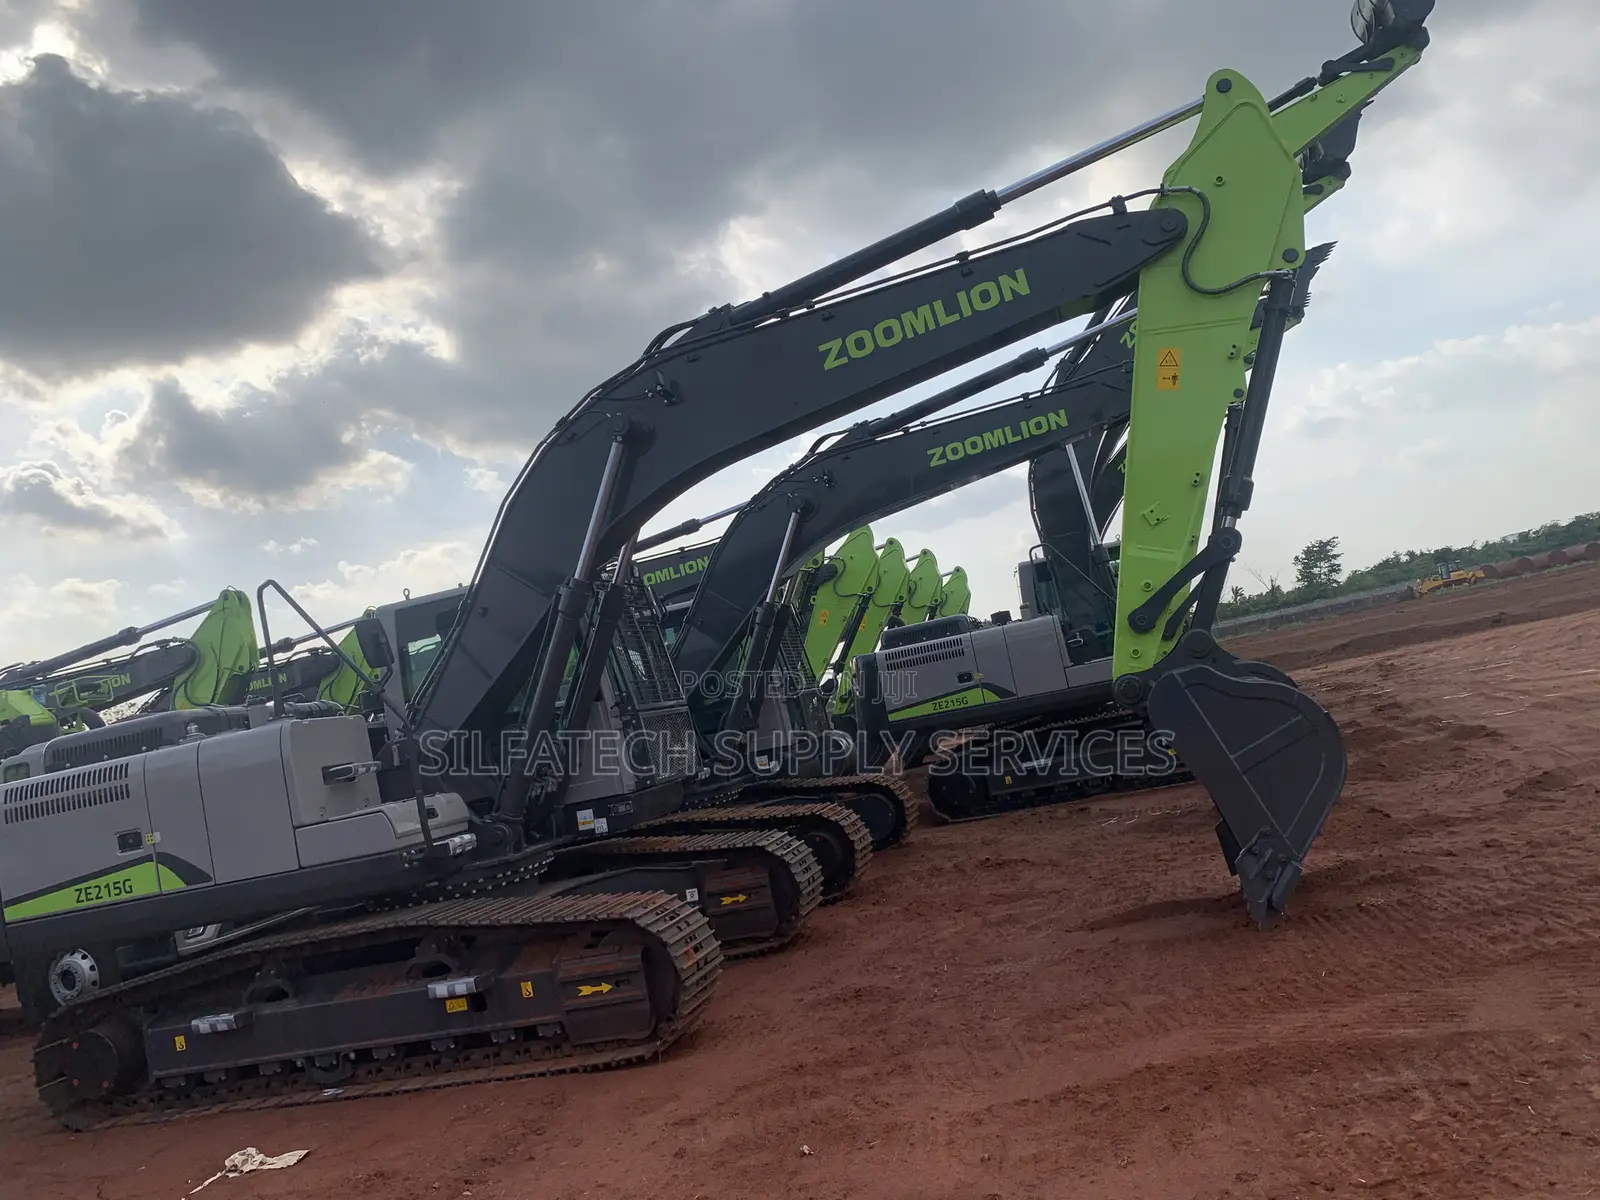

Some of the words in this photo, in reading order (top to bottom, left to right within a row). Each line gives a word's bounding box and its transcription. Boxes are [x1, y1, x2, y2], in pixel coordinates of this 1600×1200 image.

[818, 268, 1031, 371] ZOOMLION
[927, 408, 1069, 467] ZOOMLION
[932, 696, 969, 711] ZE215G
[74, 878, 133, 904] ZE215G
